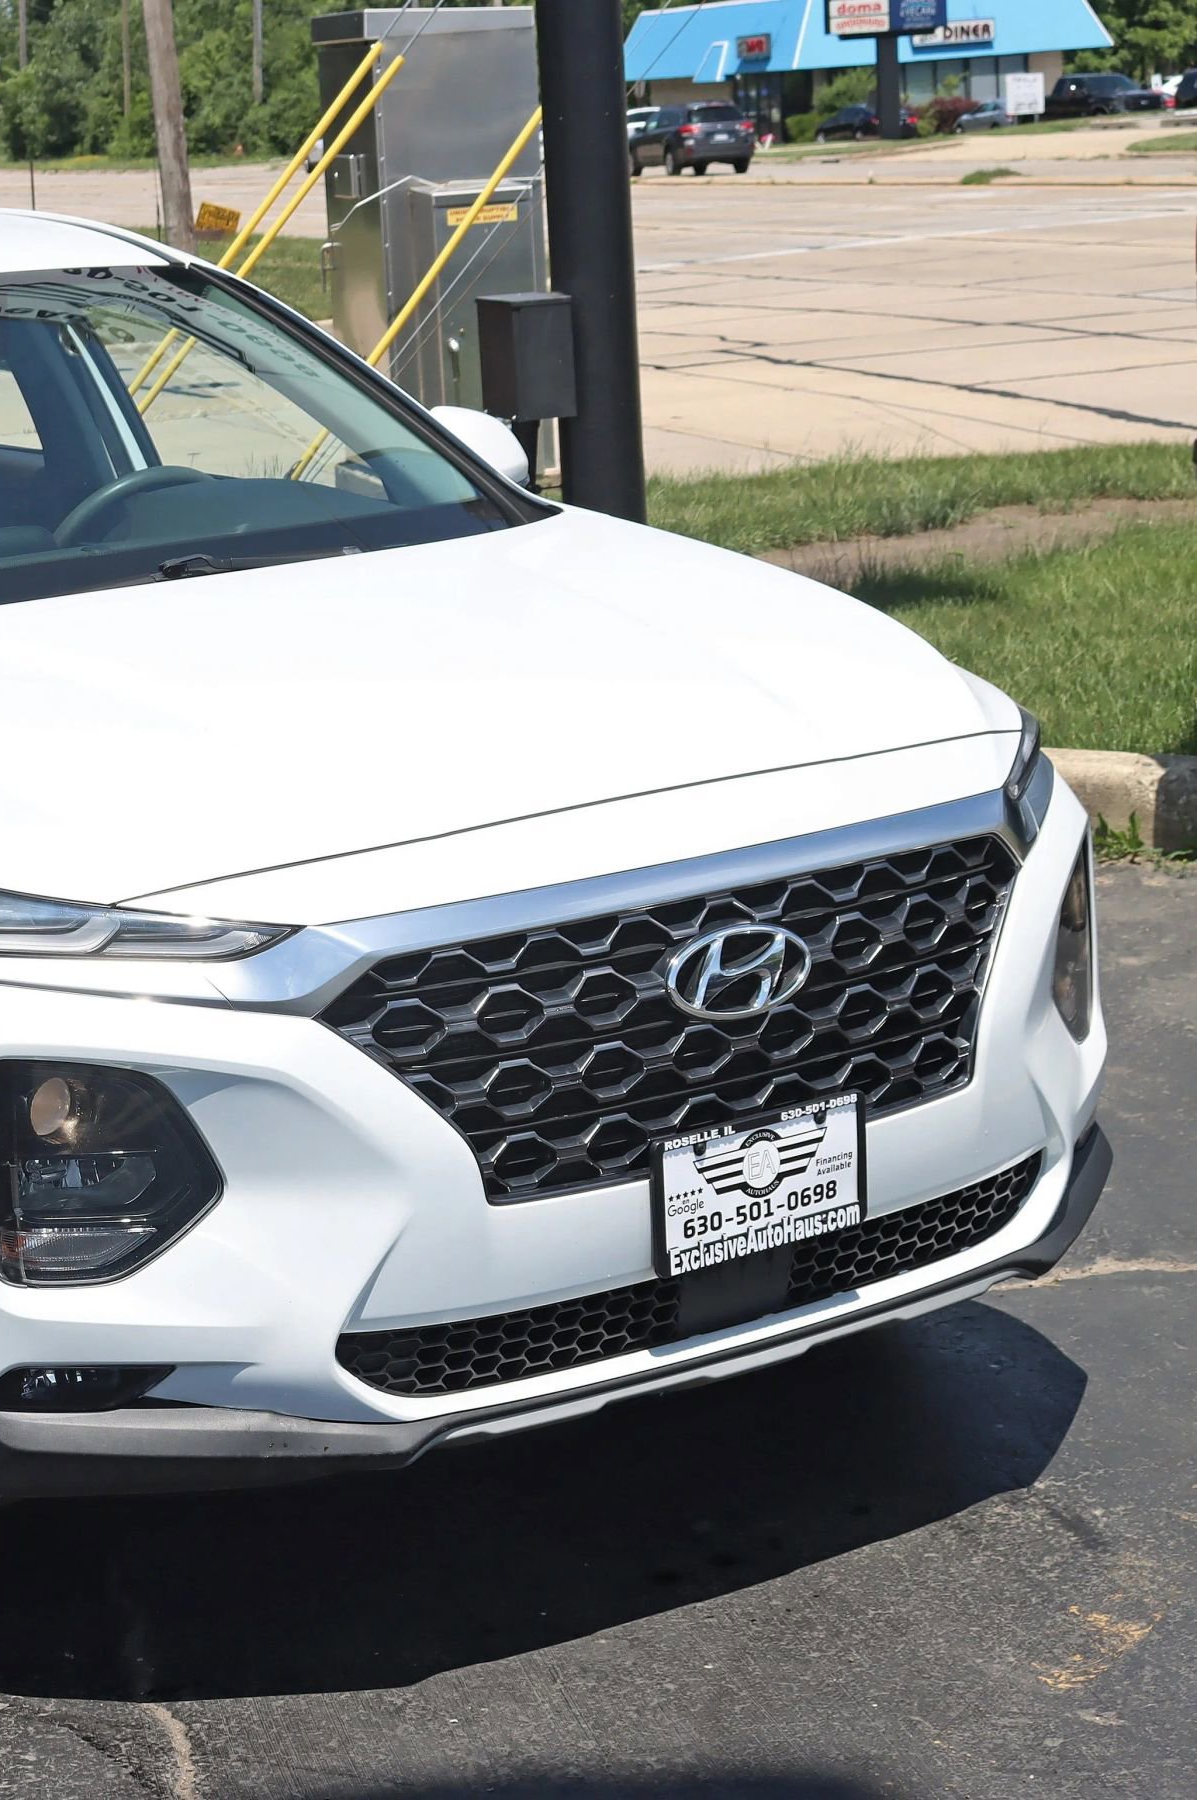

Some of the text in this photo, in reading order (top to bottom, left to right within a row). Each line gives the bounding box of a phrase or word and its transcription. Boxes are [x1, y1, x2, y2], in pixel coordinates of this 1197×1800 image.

[837, 1, 882, 15] doma
[943, 23, 991, 40] DINER
[781, 1093, 858, 1121] 630-501-0698
[664, 1125, 736, 1151] ROSELLE, IL
[745, 1132, 776, 1148] EXCLUSIVE
[747, 1149, 777, 1181] EA
[815, 1151, 853, 1166] Financing
[816, 1161, 852, 1176] Available
[746, 1179, 781, 1196] AUTOHAUS
[667, 1198, 705, 1217] Google
[683, 1180, 837, 1239] 630-501-0698
[669, 1204, 861, 1277] ExclusiveAutoHaus.com
